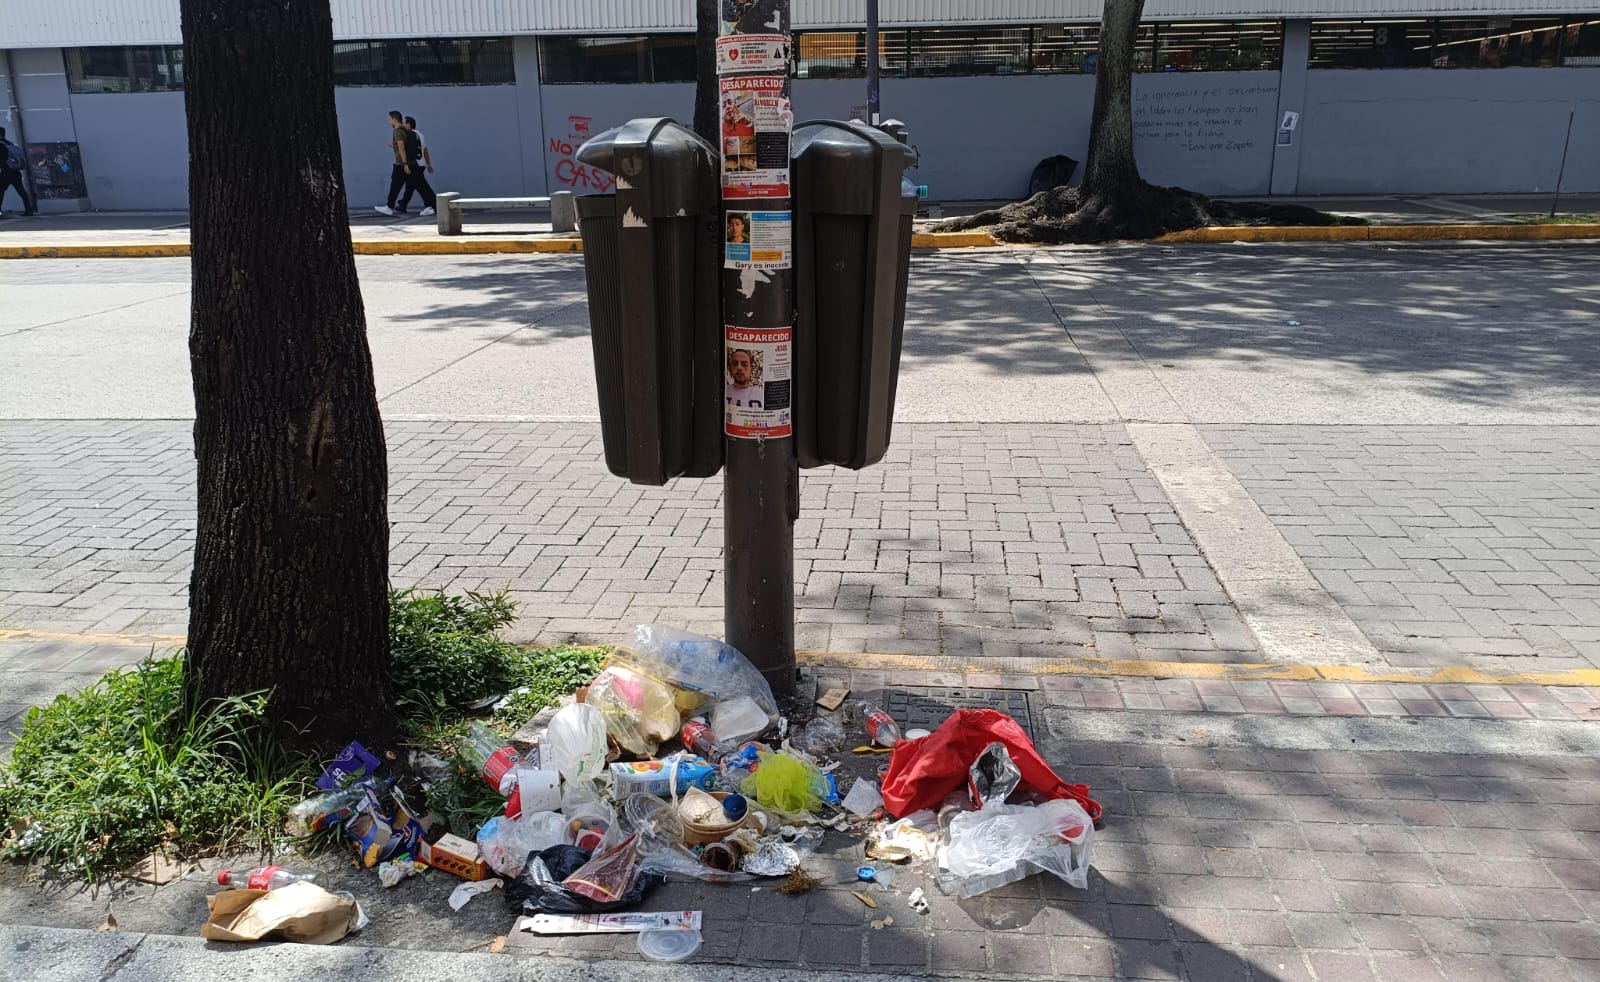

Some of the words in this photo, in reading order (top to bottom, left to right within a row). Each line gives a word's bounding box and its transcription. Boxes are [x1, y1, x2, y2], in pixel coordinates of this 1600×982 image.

[722, 79, 784, 91] DESAPARECIDO
[1151, 89, 1198, 102] ignorancia
[1211, 87, 1221, 96] el
[1188, 104, 1220, 117] tiempos
[1239, 103, 1258, 116] han
[1233, 118, 1243, 126] de
[1184, 129, 1193, 137] la
[549, 137, 573, 155] NO
[729, 331, 789, 342] DESAPARECIDO
